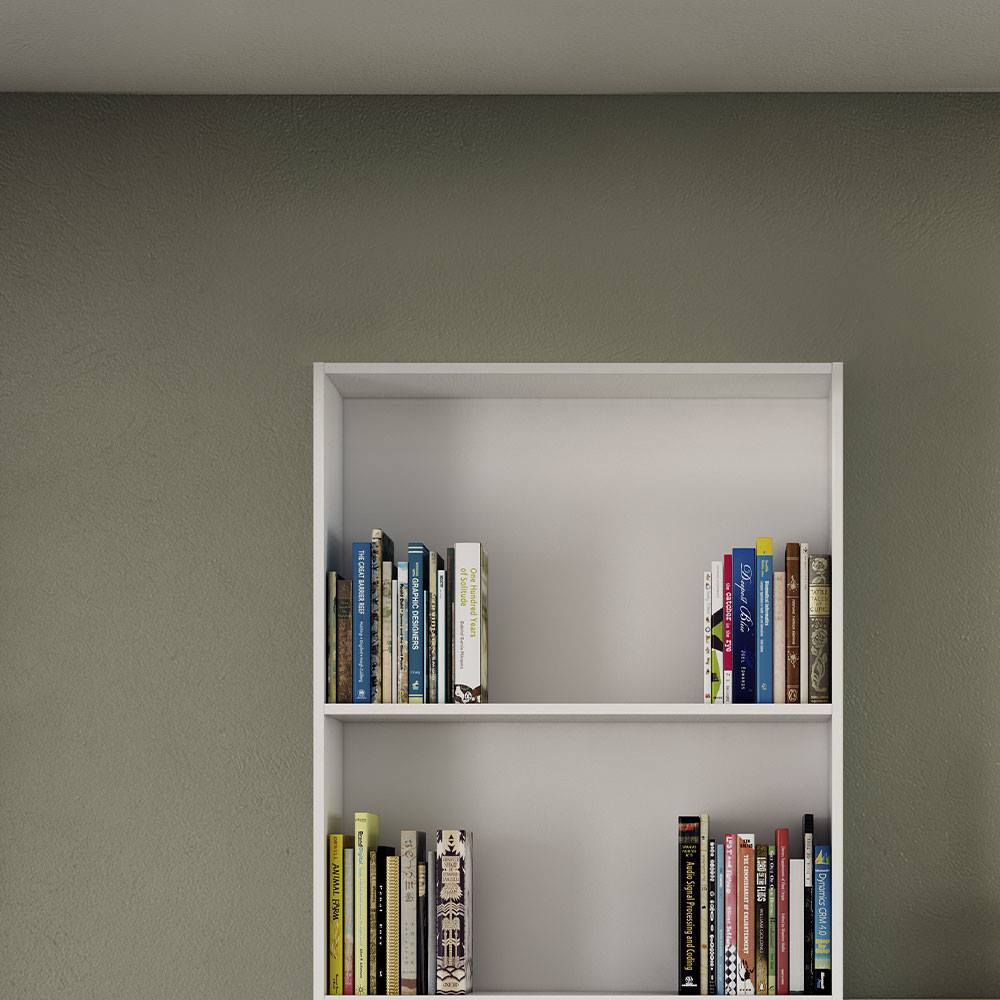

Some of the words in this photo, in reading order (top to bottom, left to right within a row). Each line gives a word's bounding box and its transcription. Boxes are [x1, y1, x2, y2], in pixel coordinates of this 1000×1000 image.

[735, 563, 752, 604] Deepest
[740, 606, 754, 633] Blue
[686, 862, 695, 879] Audio
[757, 856, 766, 872] LORD
[684, 880, 695, 900] Signal
[757, 886, 766, 902] FLIES
[817, 872, 826, 906] Dynamics
[684, 902, 695, 935] Processing
[686, 936, 695, 948] and
[684, 948, 695, 970] Coding
